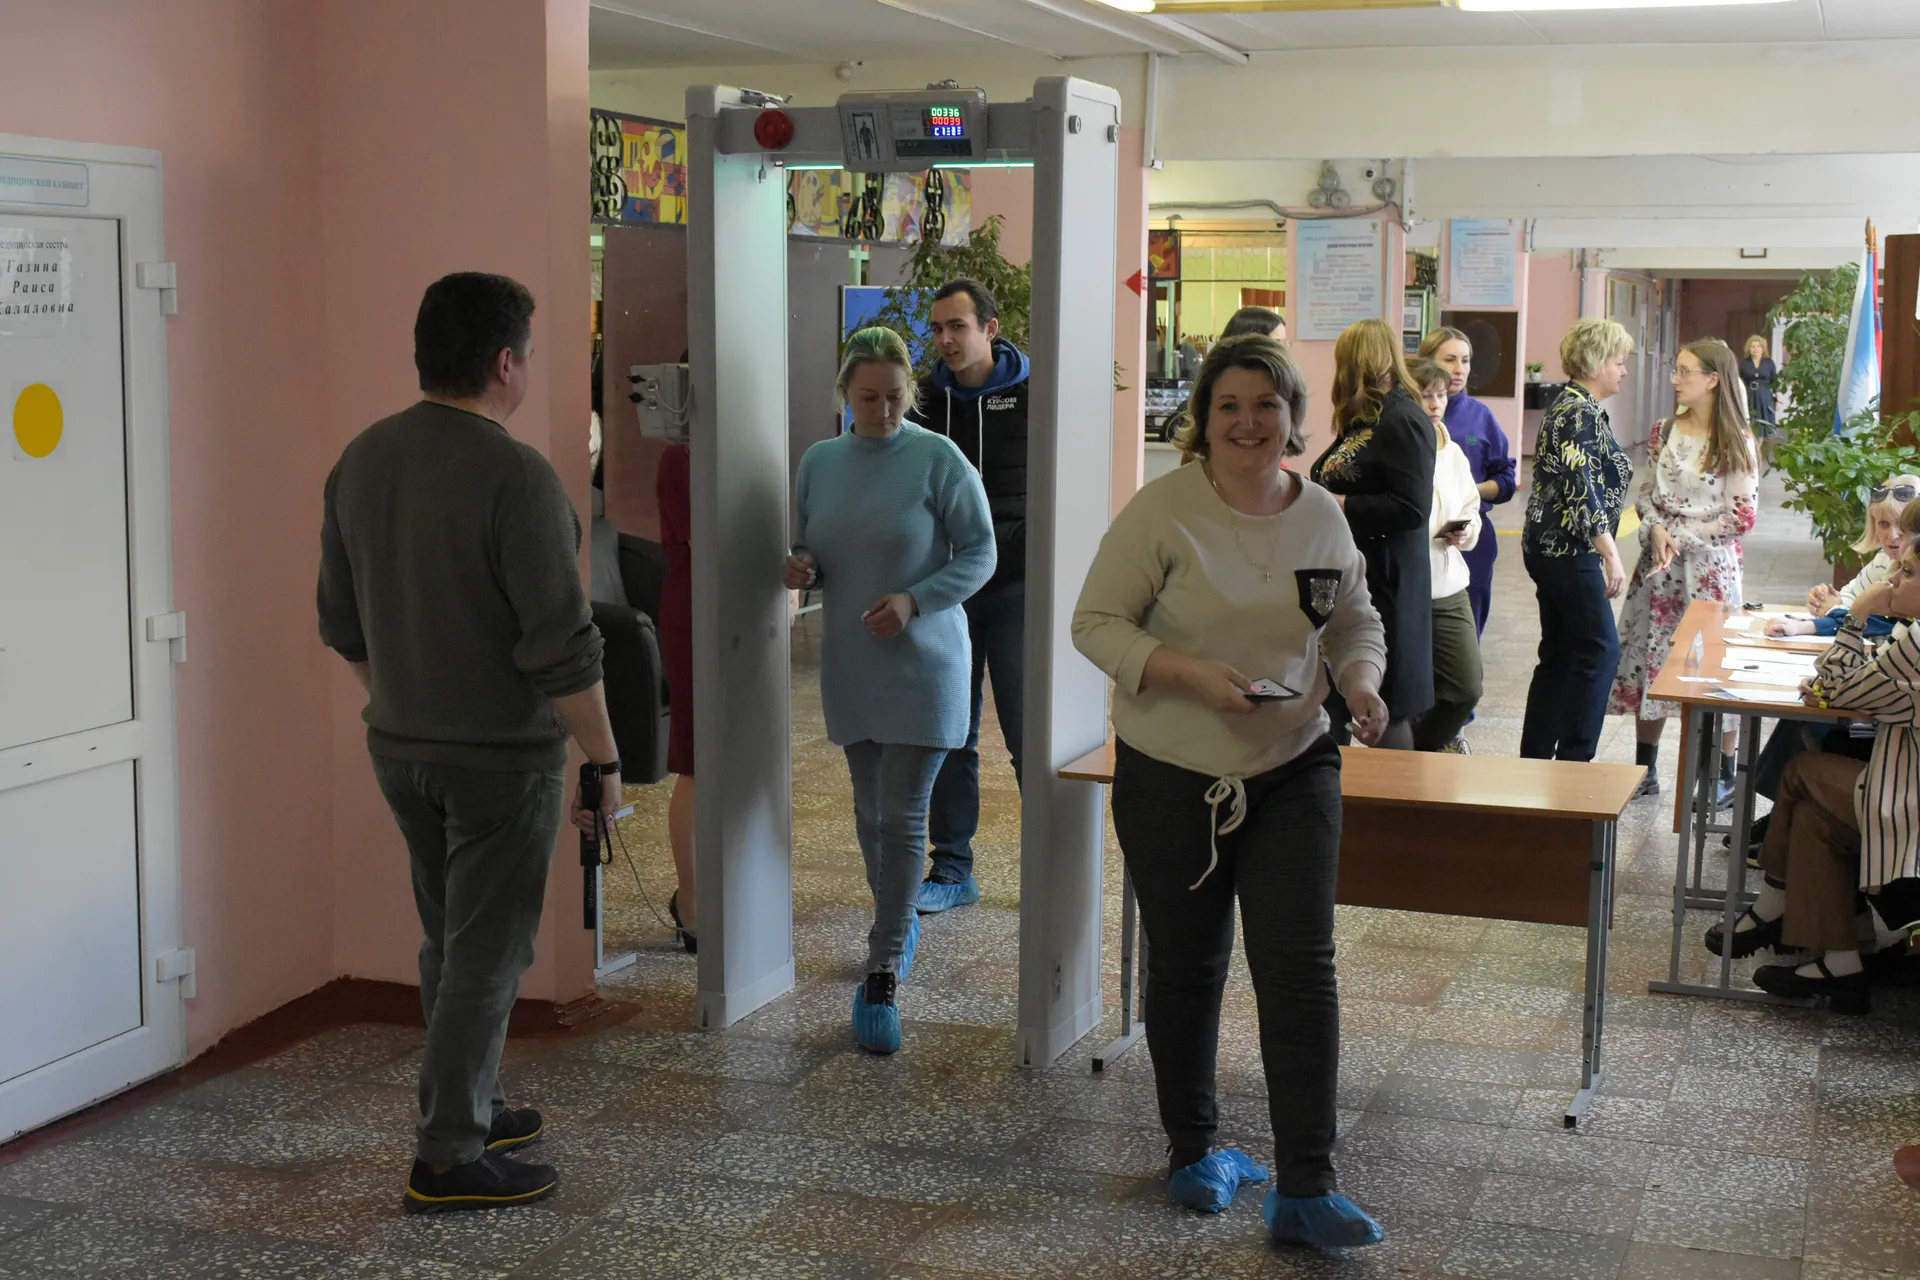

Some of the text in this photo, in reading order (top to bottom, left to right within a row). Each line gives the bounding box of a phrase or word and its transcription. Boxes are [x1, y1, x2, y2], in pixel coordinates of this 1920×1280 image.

[931, 107, 960, 117] 00336
[932, 116, 961, 126] 00039
[52, 179, 84, 191] КАБИНЕТ
[0, 240, 69, 252] едицинская сестра
[6, 259, 59, 273] Газина
[12, 279, 55, 294] Раиса
[986, 403, 1015, 411] ЛИДЕРА
